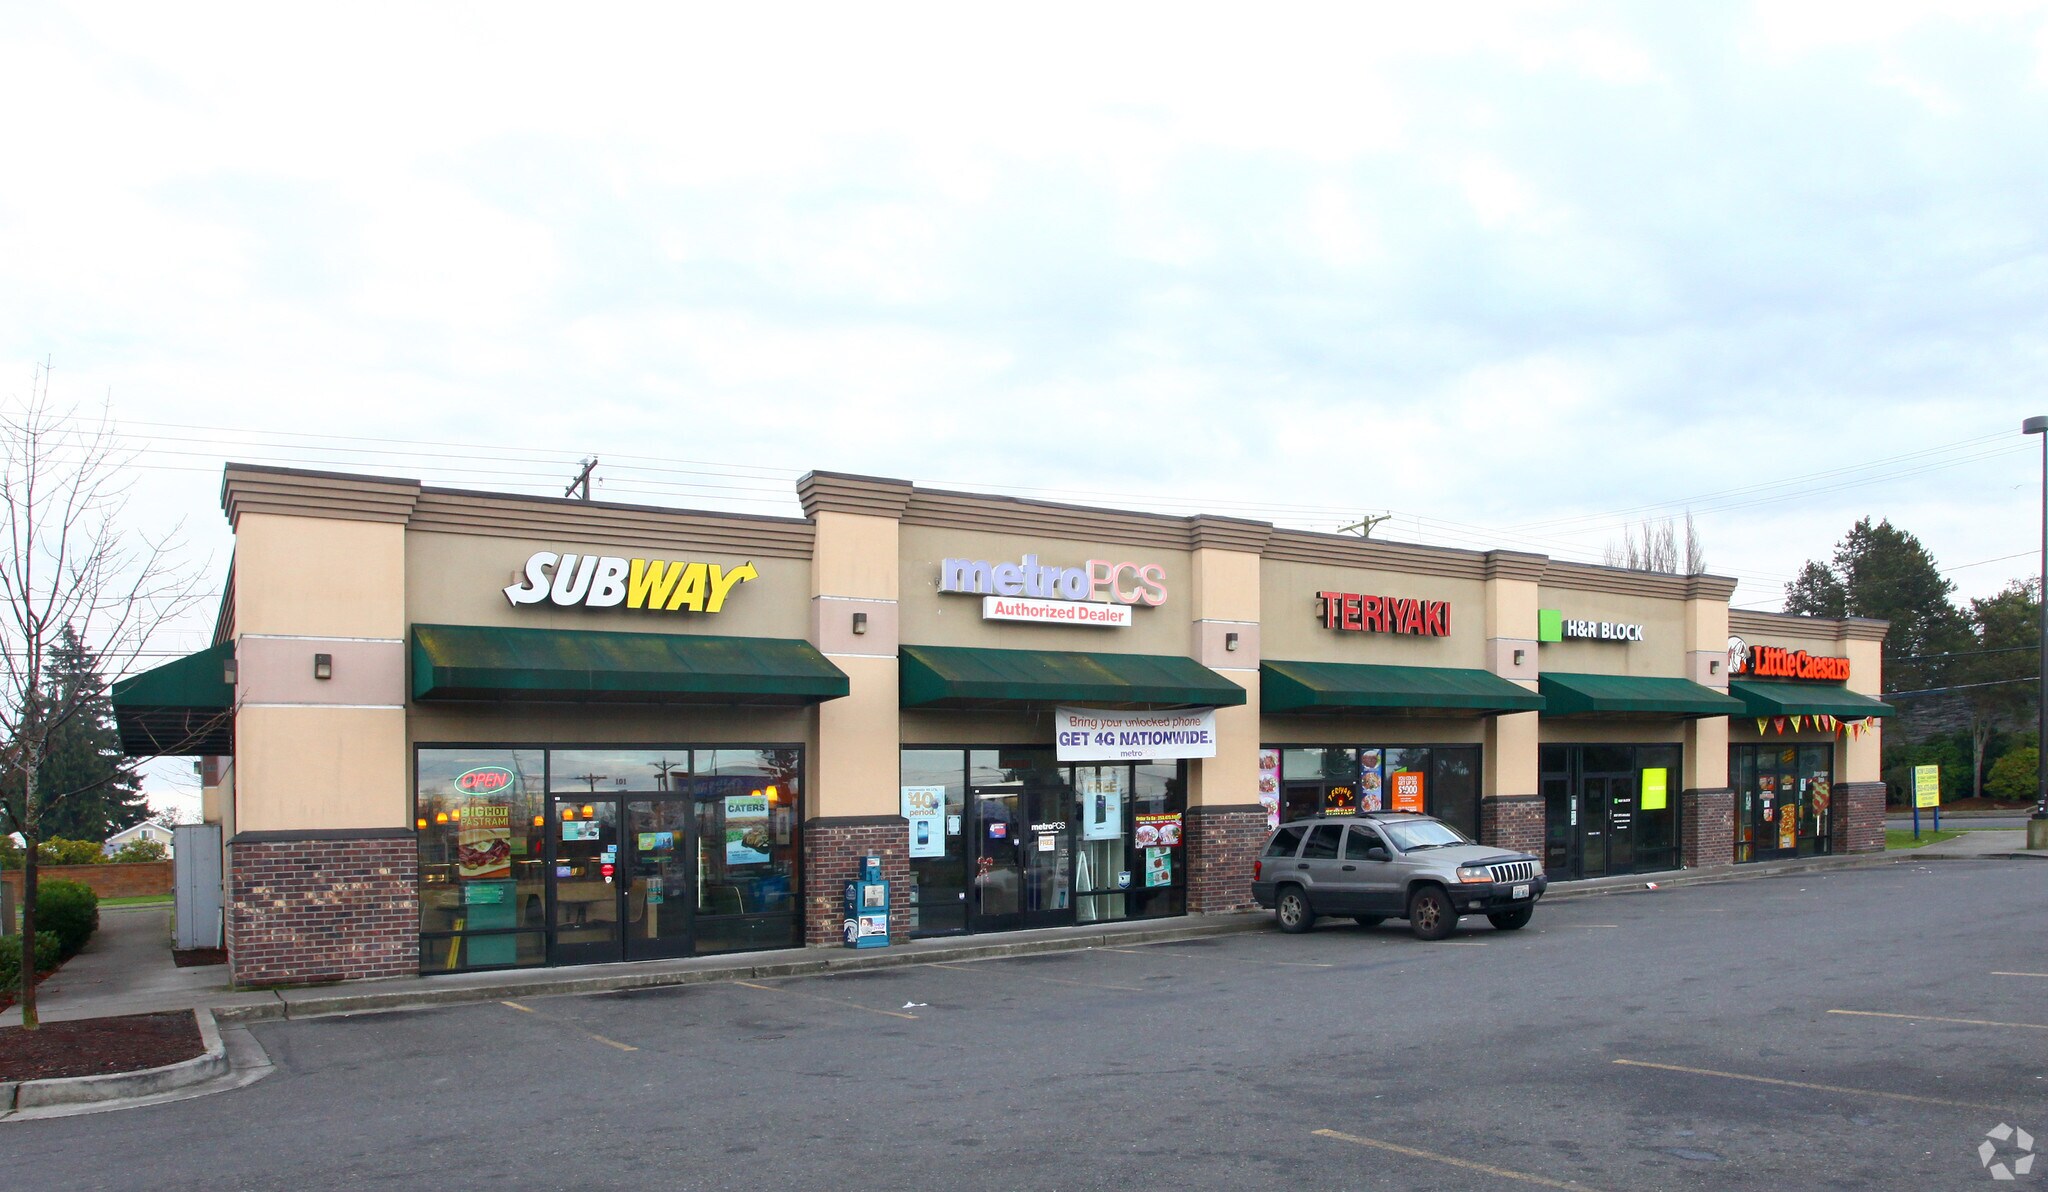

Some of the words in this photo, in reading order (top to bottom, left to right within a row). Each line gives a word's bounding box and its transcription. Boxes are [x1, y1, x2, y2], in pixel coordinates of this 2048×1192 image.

[504, 551, 759, 613] SUBWAY
[941, 554, 1168, 606] metroPCS
[994, 600, 1075, 620] Authorized
[1078, 608, 1125, 622] Dealer
[1317, 591, 1451, 637] TERIYAKI
[1566, 619, 1597, 639] H&R
[1601, 621, 1644, 641] BLOCK
[1752, 645, 1796, 677] Little
[1795, 650, 1850, 681] Caesars
[1069, 716, 1098, 730] Bring
[1100, 719, 1123, 730] your
[1125, 717, 1170, 727] unlocked
[1172, 716, 1201, 729] phone
[1058, 731, 1090, 747] GET
[1094, 731, 1116, 747] 4G
[1119, 730, 1213, 746] NATIONWIDE.
[461, 773, 508, 789] OPEN
[615, 778, 627, 786] 101
[1327, 786, 1354, 802] TERIYAKI
[461, 806, 485, 817] BIG
[486, 806, 507, 817] HOT
[728, 803, 765, 813] CATERS
[461, 817, 509, 827] PASTRAMI
[1031, 822, 1066, 831] metroPCS
